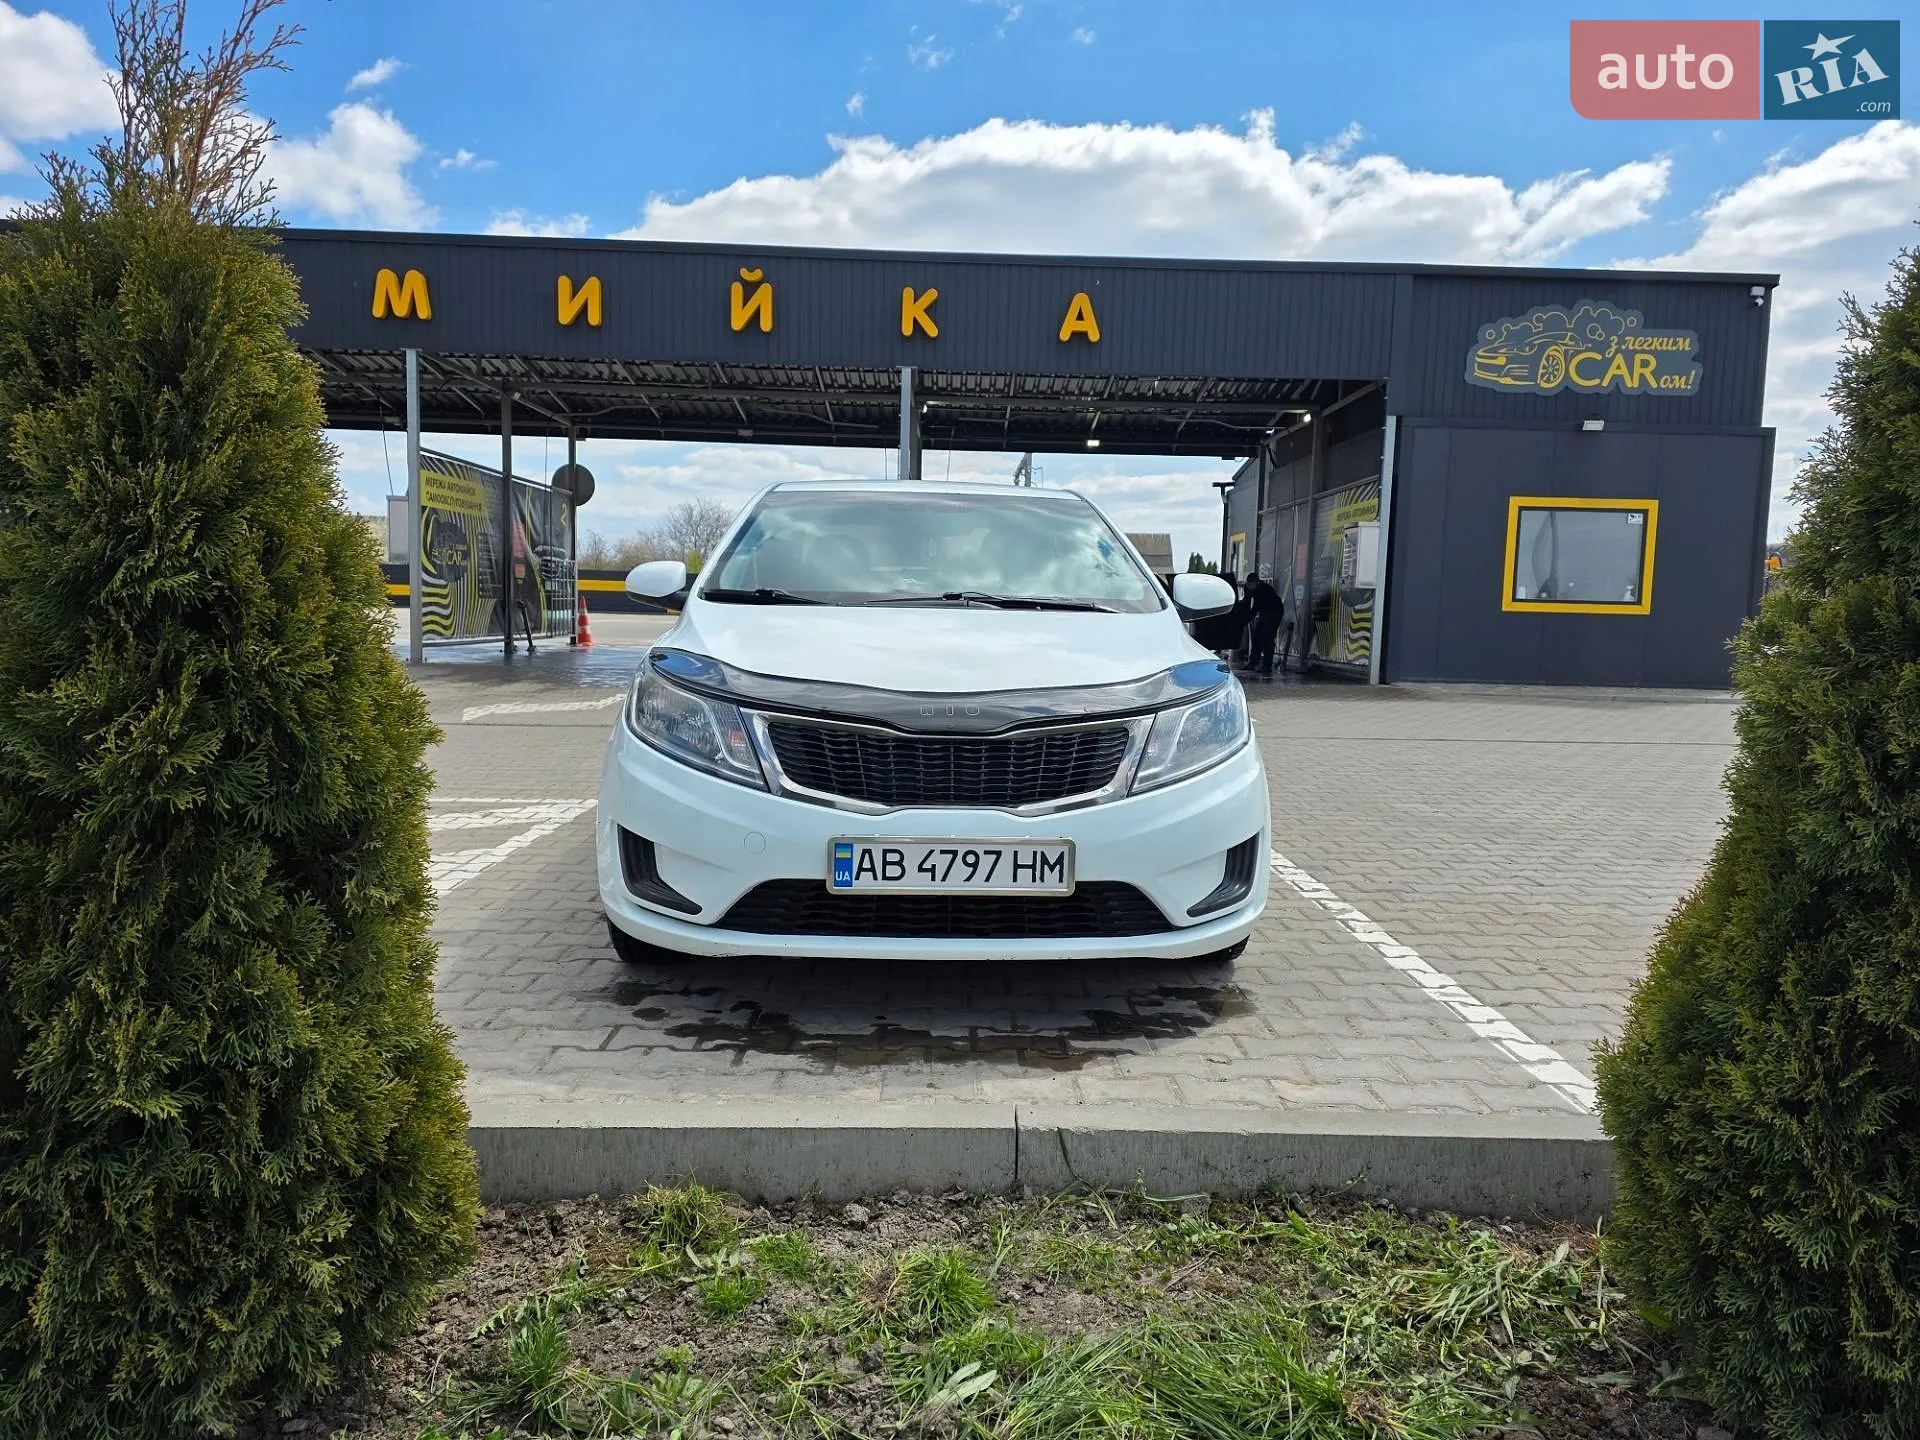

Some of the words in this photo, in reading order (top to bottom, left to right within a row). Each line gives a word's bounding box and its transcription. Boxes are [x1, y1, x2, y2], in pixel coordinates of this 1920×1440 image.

[372, 268, 1101, 343] МИЙКА
[1605, 336, 1619, 358] з
[1621, 336, 1692, 351] легким
[835, 871, 851, 882] UA
[854, 849, 906, 881] AB
[917, 849, 1003, 883] 4797
[1012, 850, 1065, 884] HM
